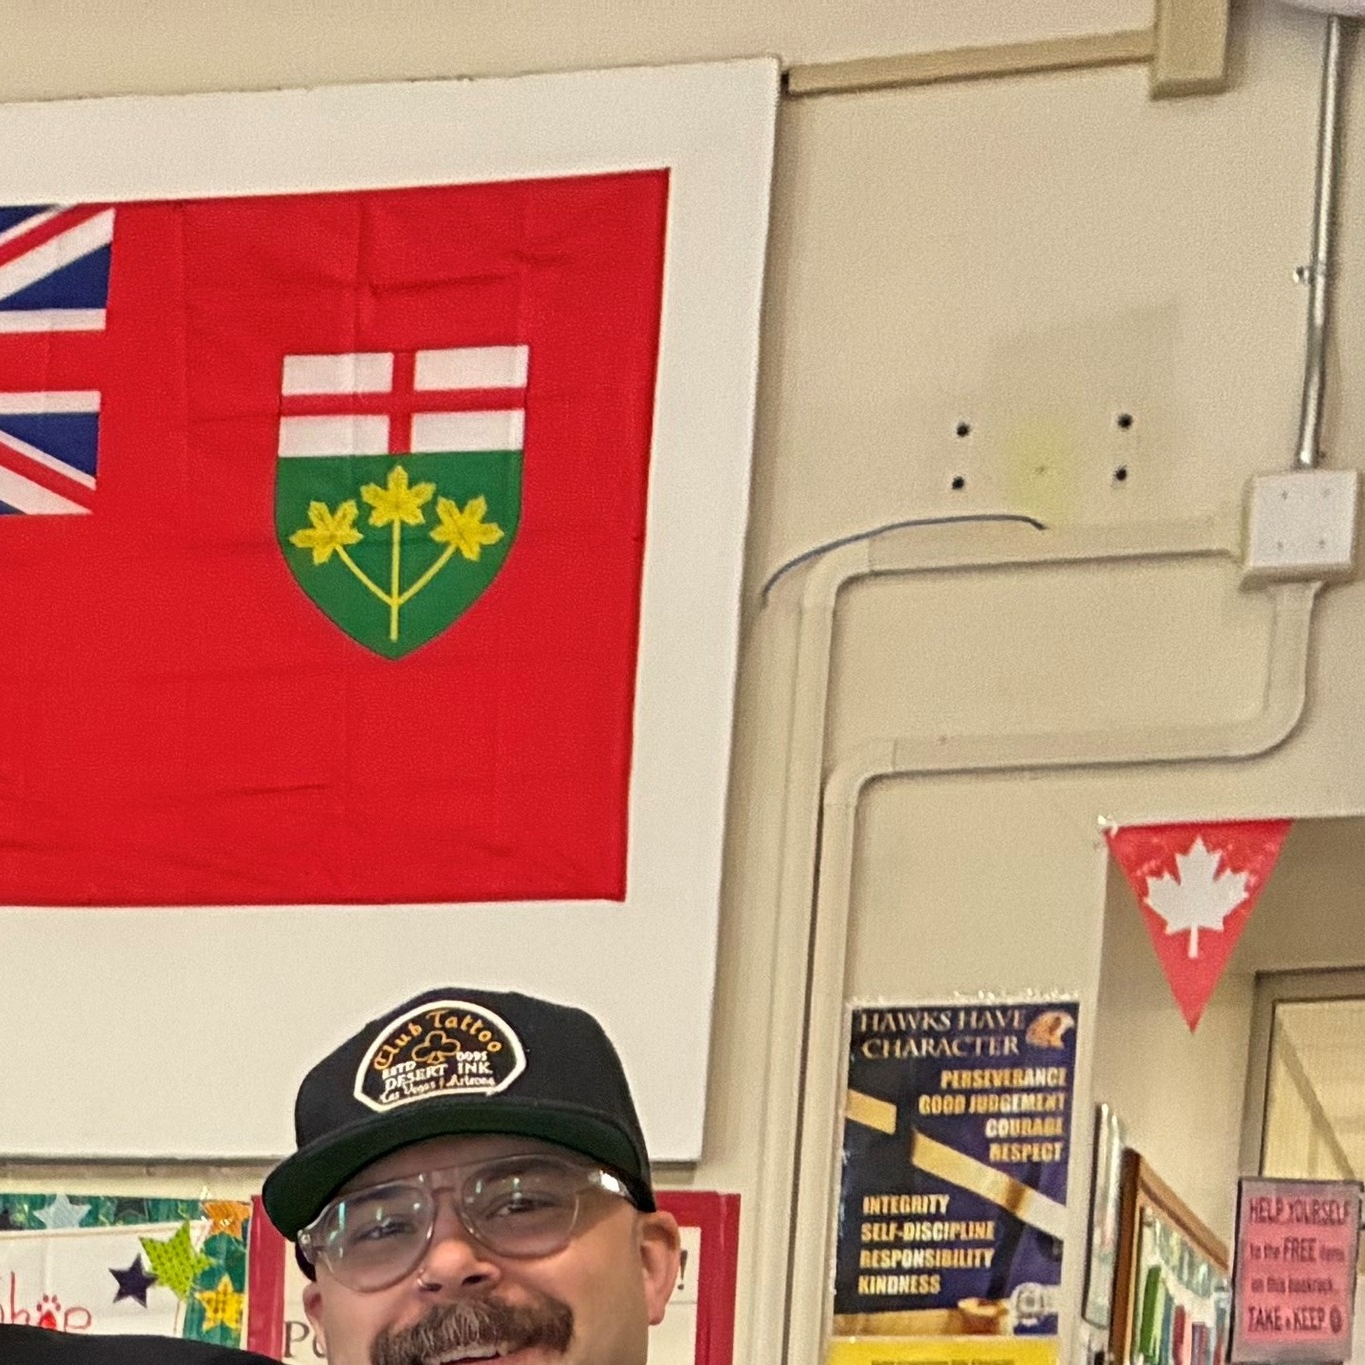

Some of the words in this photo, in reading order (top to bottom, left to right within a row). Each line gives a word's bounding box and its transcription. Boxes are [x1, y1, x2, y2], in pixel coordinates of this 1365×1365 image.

[860, 1010, 952, 1032] HAWKS
[958, 1009, 1026, 1031] HAVE
[373, 1021, 422, 1070] Club
[426, 1009, 502, 1051] Tattoo
[862, 1034, 1019, 1059] CHARACTER
[941, 1066, 1067, 1089] PERSEVERANCE
[919, 1094, 966, 1115] GOOD
[969, 1092, 1065, 1114] JUDGEMENT
[985, 1117, 1063, 1138] COURAGE
[989, 1142, 1063, 1162] RESPECT
[862, 1194, 950, 1216] INTEGRITY
[1249, 1196, 1284, 1223] HELP
[1287, 1198, 1350, 1226] YOURSELF
[861, 1221, 995, 1242] SELF-DISCIPLINE
[859, 1248, 995, 1269] RESPONSIBILITY
[1283, 1236, 1316, 1262] FREE
[858, 1274, 941, 1295] KINDNESS
[1248, 1305, 1281, 1332] TAKE
[1293, 1306, 1325, 1331] KEEP
